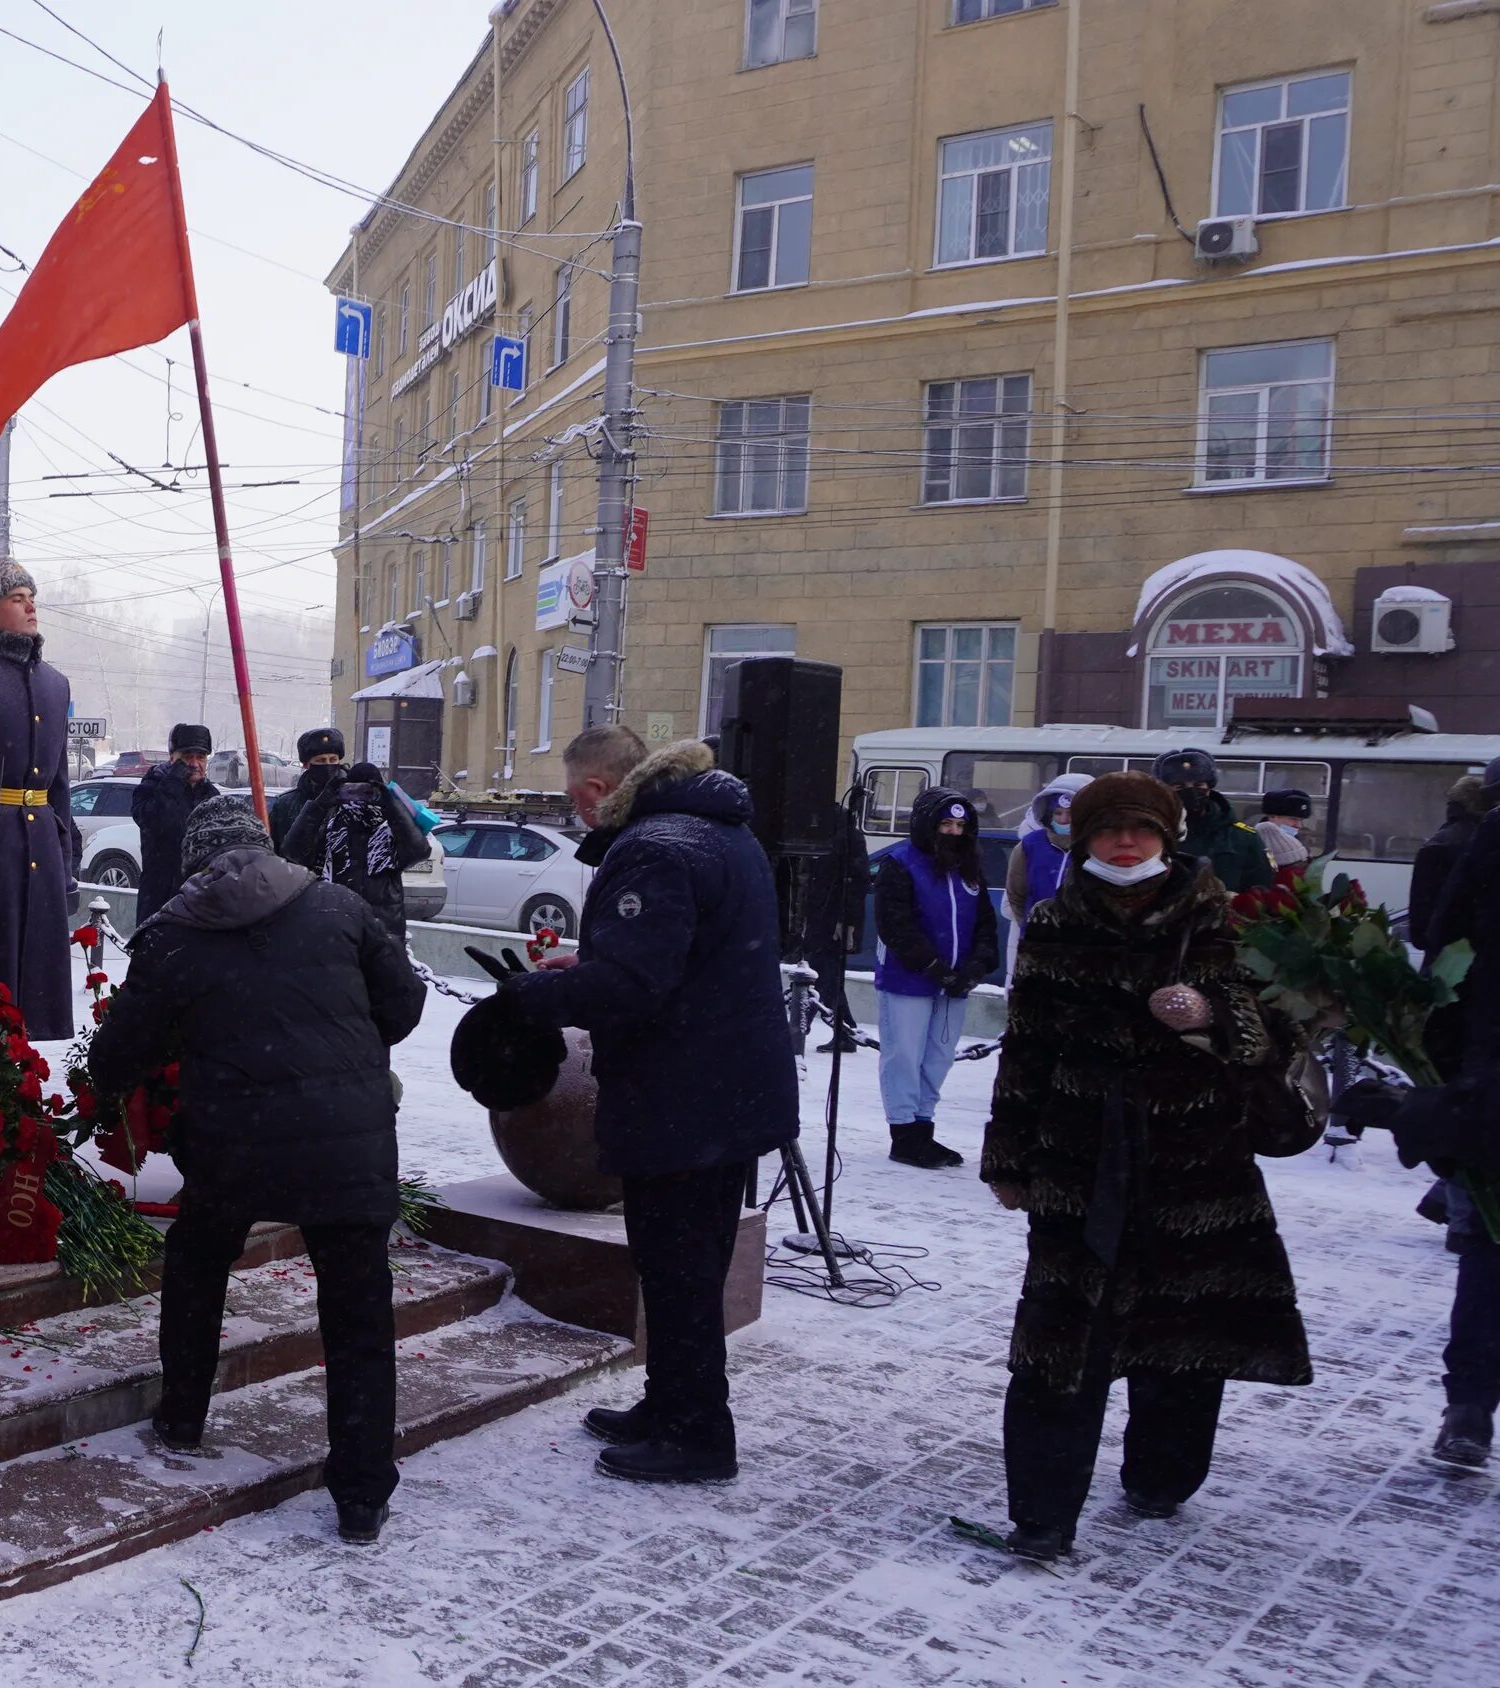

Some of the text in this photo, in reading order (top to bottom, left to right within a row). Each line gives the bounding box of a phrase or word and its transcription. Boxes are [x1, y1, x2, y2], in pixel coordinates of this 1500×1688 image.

[442, 259, 496, 348] ОКСИД
[1167, 622, 1287, 644] МЕХА
[1166, 660, 1275, 678] SKIN ART
[651, 724, 669, 739] 32
[7, 1169, 39, 1227] НСО
